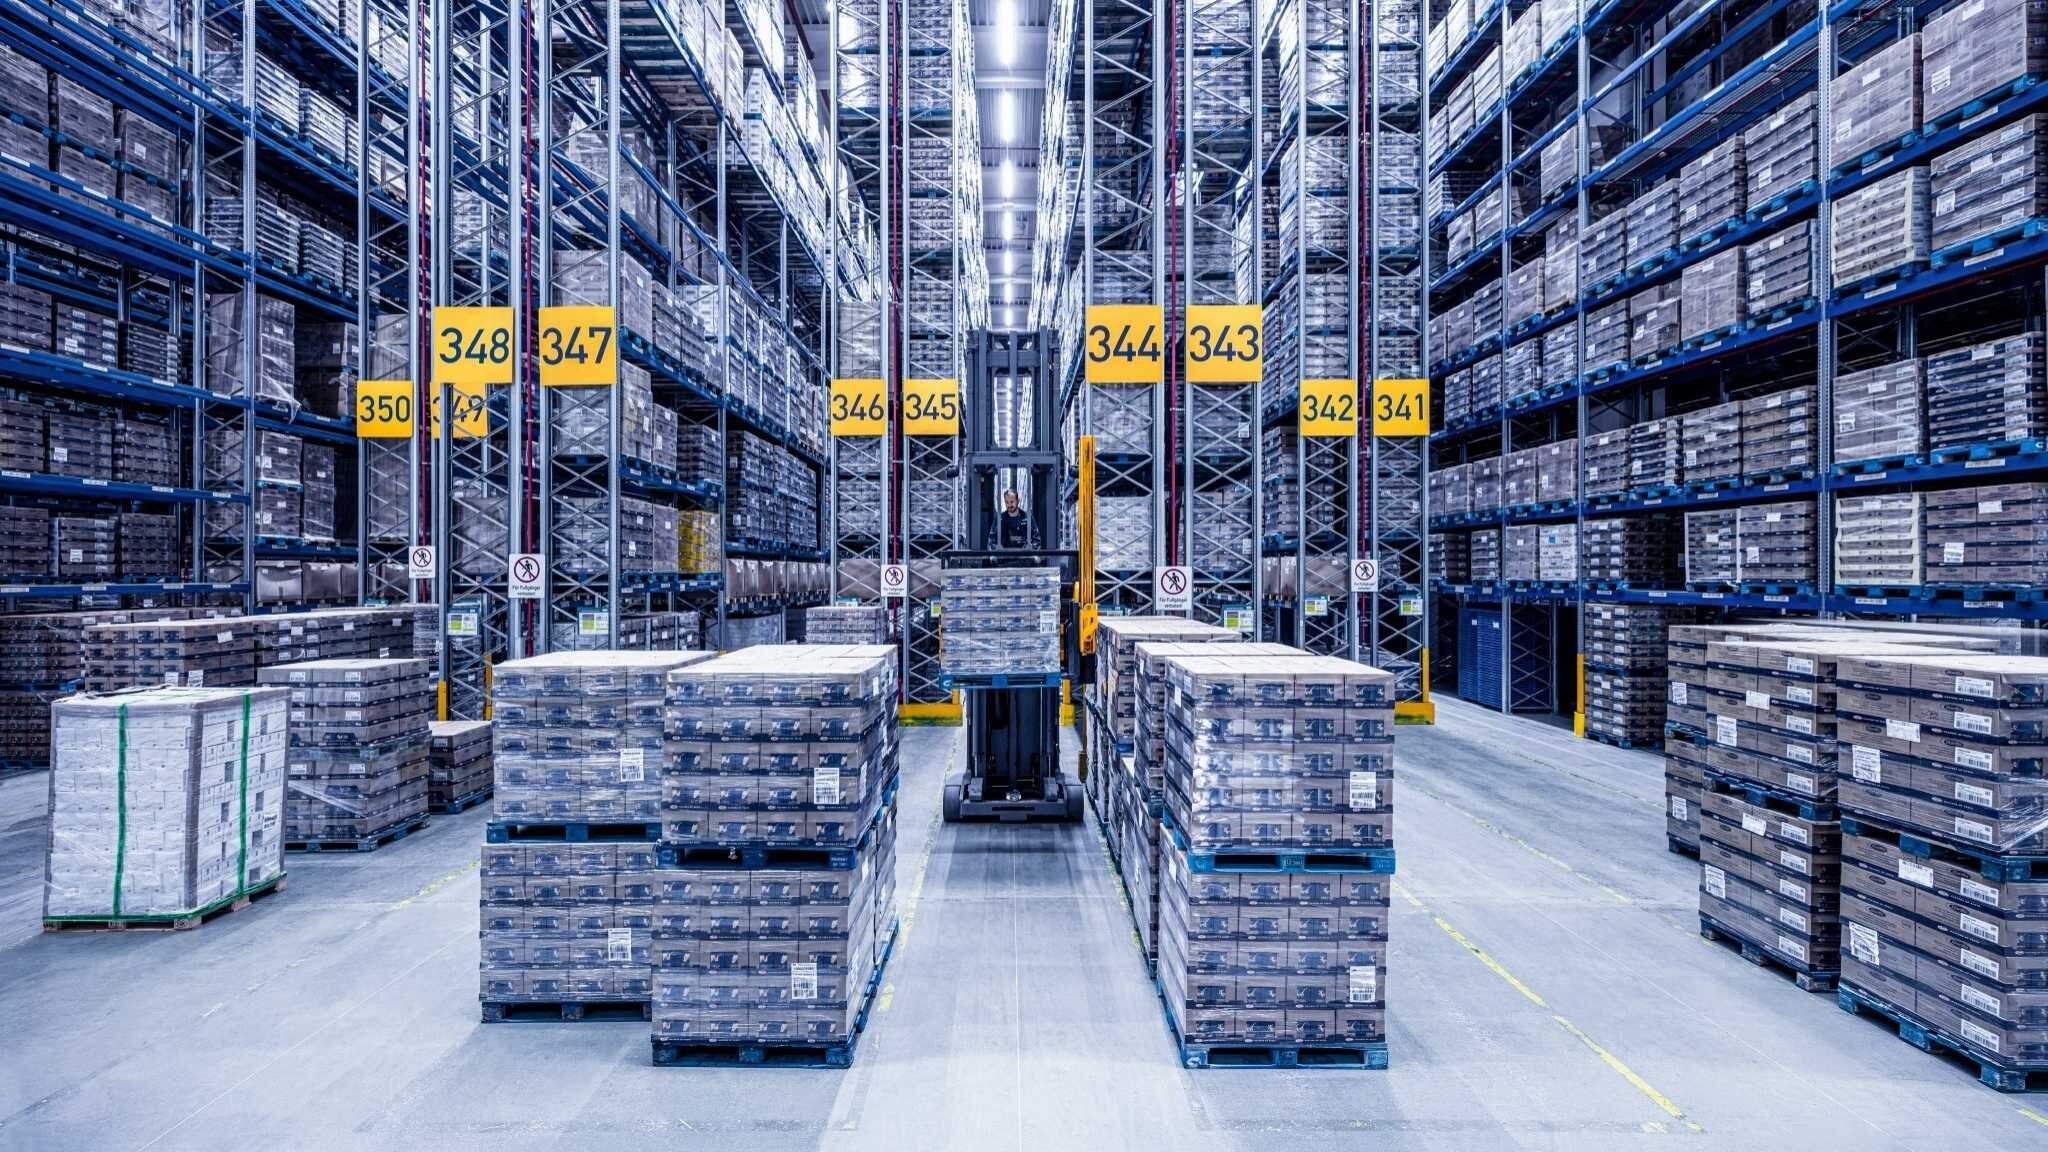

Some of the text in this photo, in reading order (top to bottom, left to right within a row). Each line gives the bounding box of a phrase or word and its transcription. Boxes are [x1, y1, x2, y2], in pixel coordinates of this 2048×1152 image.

[439, 328, 510, 365] 348
[543, 327, 612, 364] 347
[1088, 325, 1161, 363] 344
[1189, 325, 1260, 363] 343
[359, 395, 411, 423] 350
[831, 394, 885, 421] 346
[905, 394, 957, 421] 345
[1302, 394, 1354, 422] 342
[1377, 393, 1424, 422] 341
